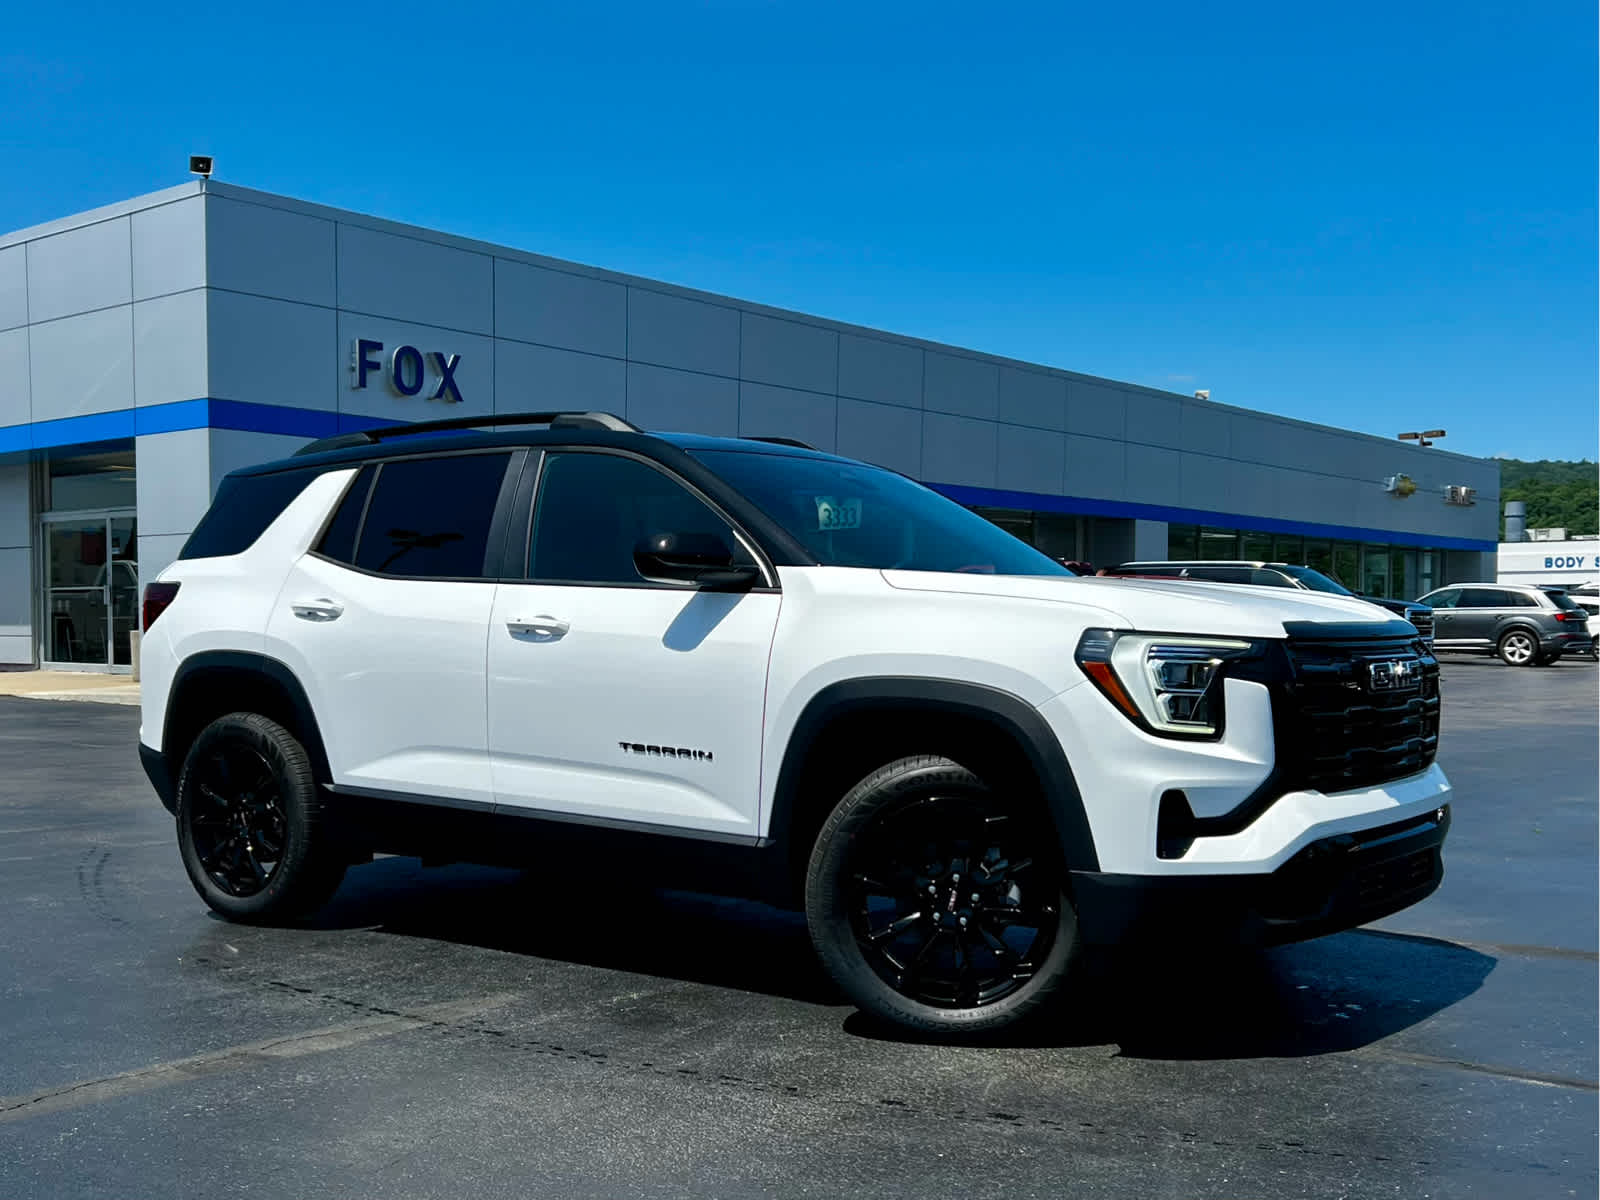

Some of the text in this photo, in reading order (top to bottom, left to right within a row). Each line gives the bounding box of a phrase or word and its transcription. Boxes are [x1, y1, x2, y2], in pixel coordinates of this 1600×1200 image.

[353, 338, 464, 403] FOX
[1544, 556, 1584, 568] BODY
[1369, 661, 1421, 690] GMC
[618, 742, 713, 761] TERRAIN
